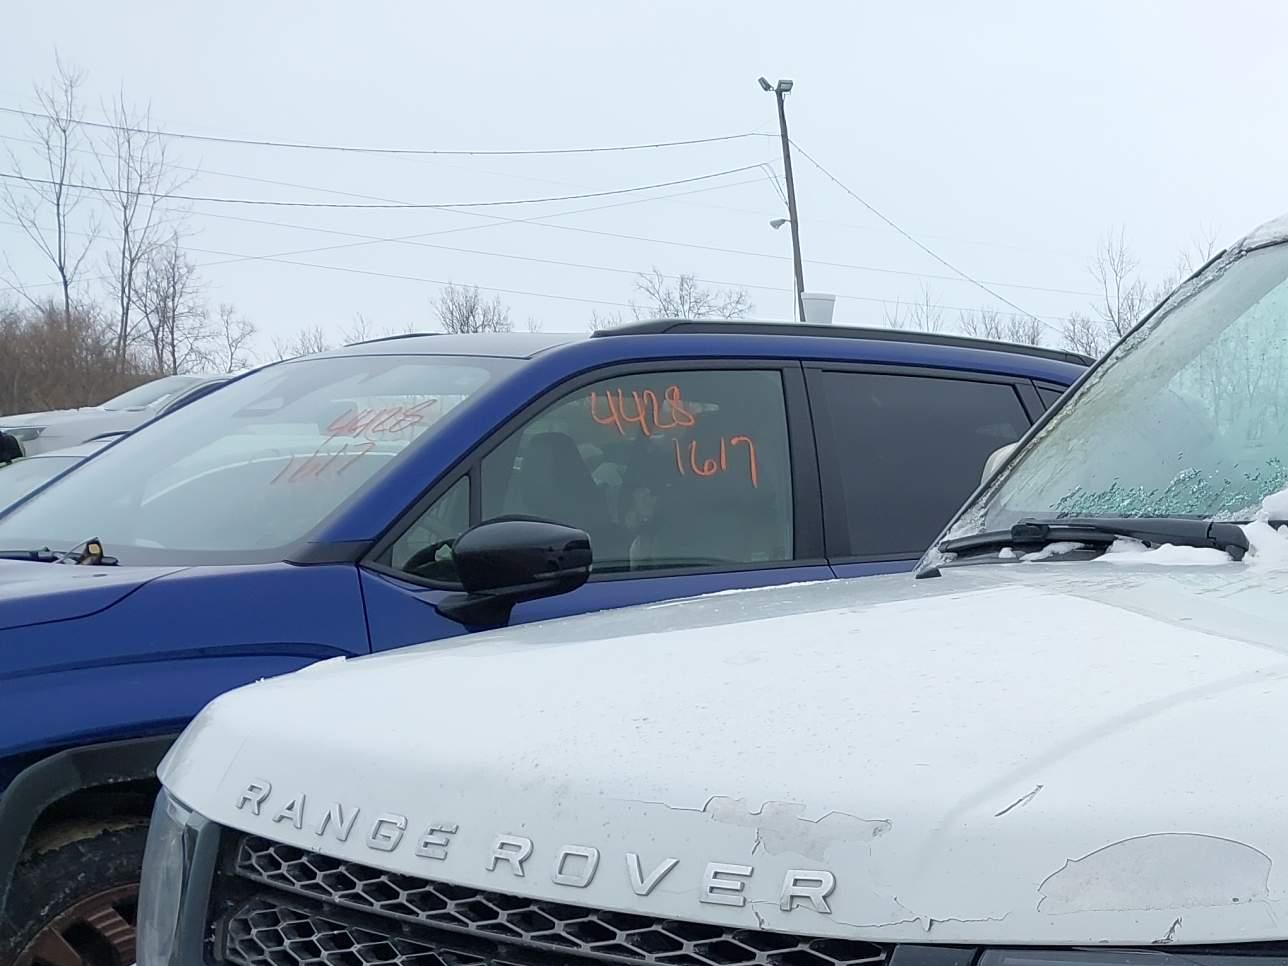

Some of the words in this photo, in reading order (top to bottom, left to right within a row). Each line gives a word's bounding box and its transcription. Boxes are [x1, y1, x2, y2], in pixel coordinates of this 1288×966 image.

[590, 384, 695, 436] 4428
[672, 435, 758, 488] 1617
[235, 777, 460, 861] RANGE
[484, 833, 837, 914] ROVER
